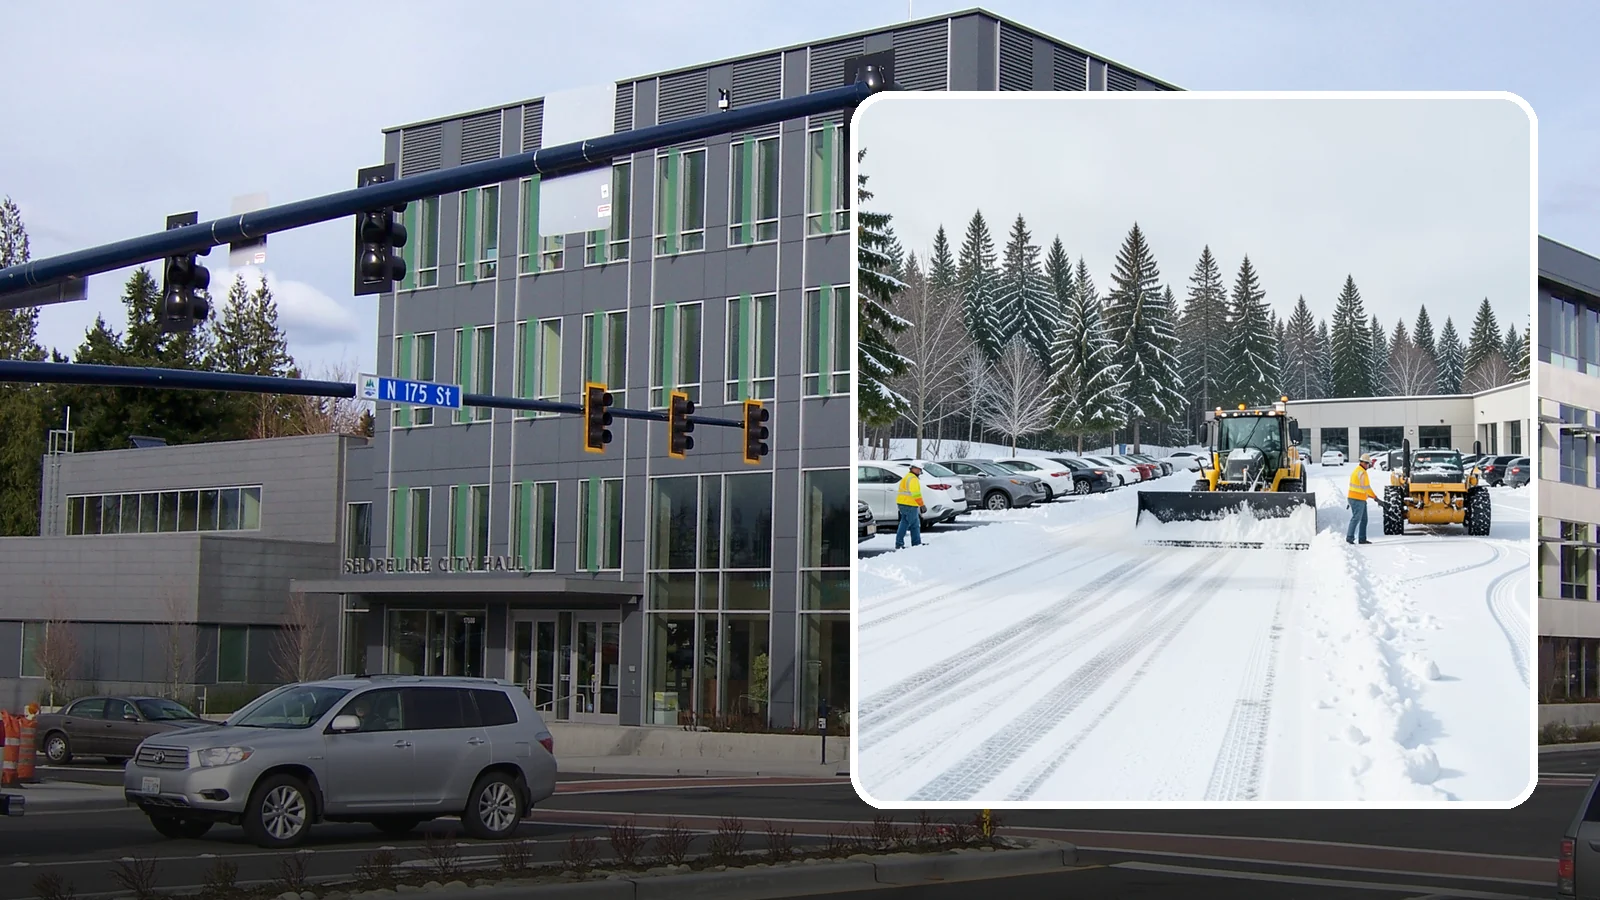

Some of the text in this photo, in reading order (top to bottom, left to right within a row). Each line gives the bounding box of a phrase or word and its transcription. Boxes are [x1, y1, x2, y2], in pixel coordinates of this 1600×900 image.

[387, 380, 451, 406] N 175 St
[344, 555, 526, 574] SHORELINE CITY HALL
